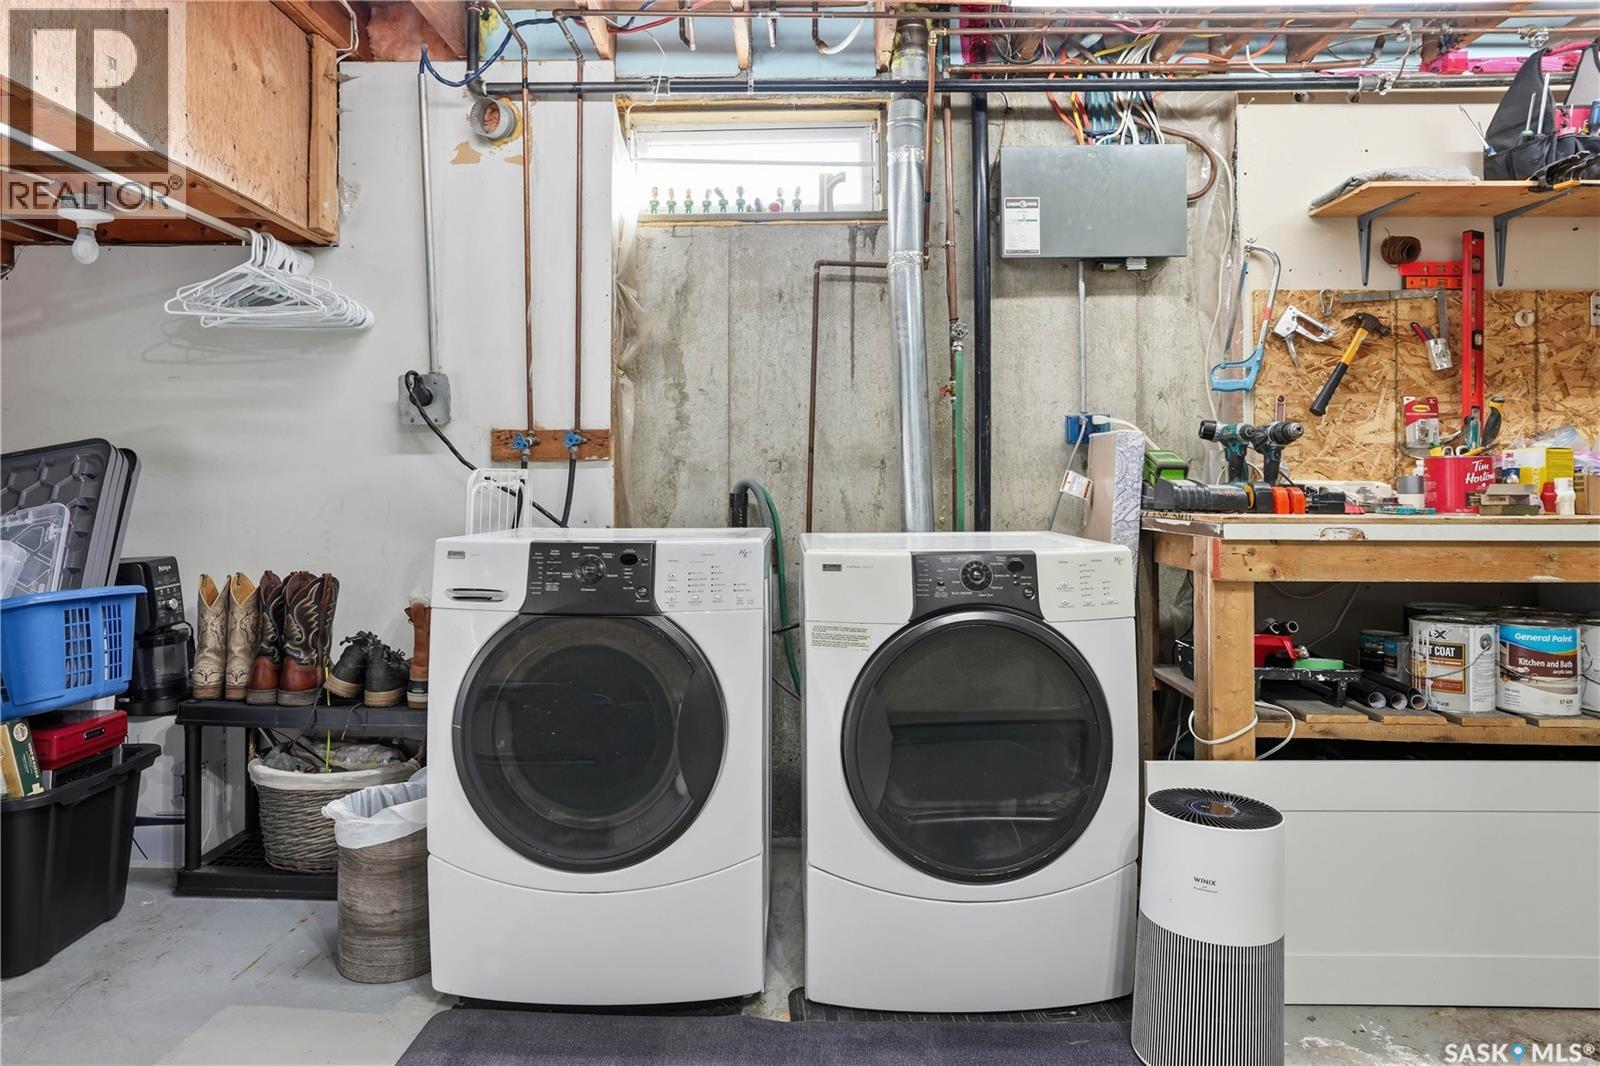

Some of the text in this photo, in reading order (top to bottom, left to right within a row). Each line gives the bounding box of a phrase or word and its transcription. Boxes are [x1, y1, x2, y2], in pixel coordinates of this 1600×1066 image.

[1472, 459, 1489, 472] Tim
[1514, 632, 1573, 643] General Paint
[1434, 646, 1455, 657] COAT
[1518, 658, 1573, 669] Kitchen and Bath
[1193, 876, 1216, 886] WINIX
